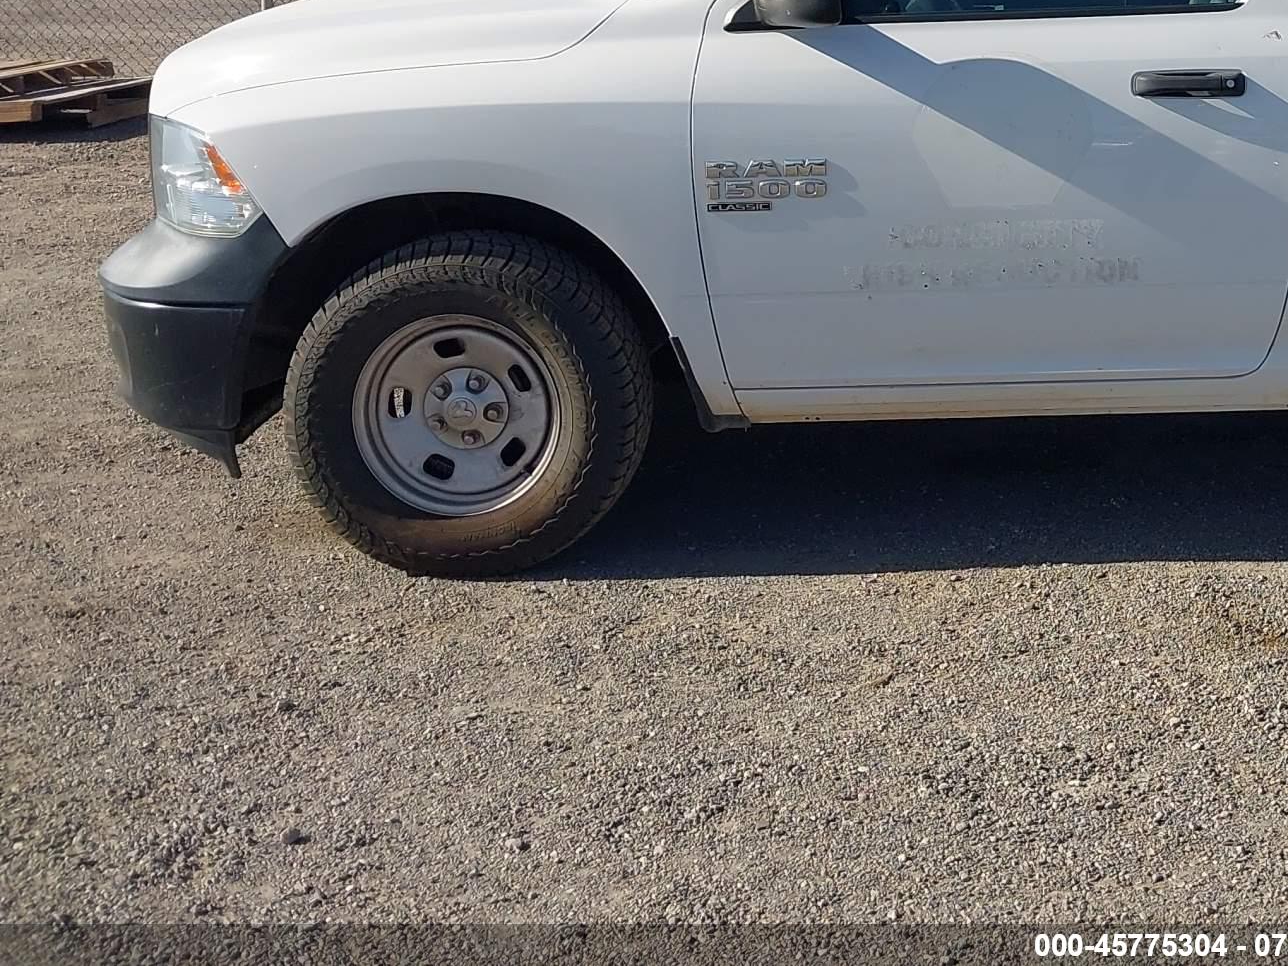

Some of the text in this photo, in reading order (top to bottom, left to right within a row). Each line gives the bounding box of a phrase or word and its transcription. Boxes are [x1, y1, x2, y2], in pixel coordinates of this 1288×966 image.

[705, 159, 827, 179] RAM
[706, 179, 828, 200] 1500
[708, 203, 770, 212] CLASSIC
